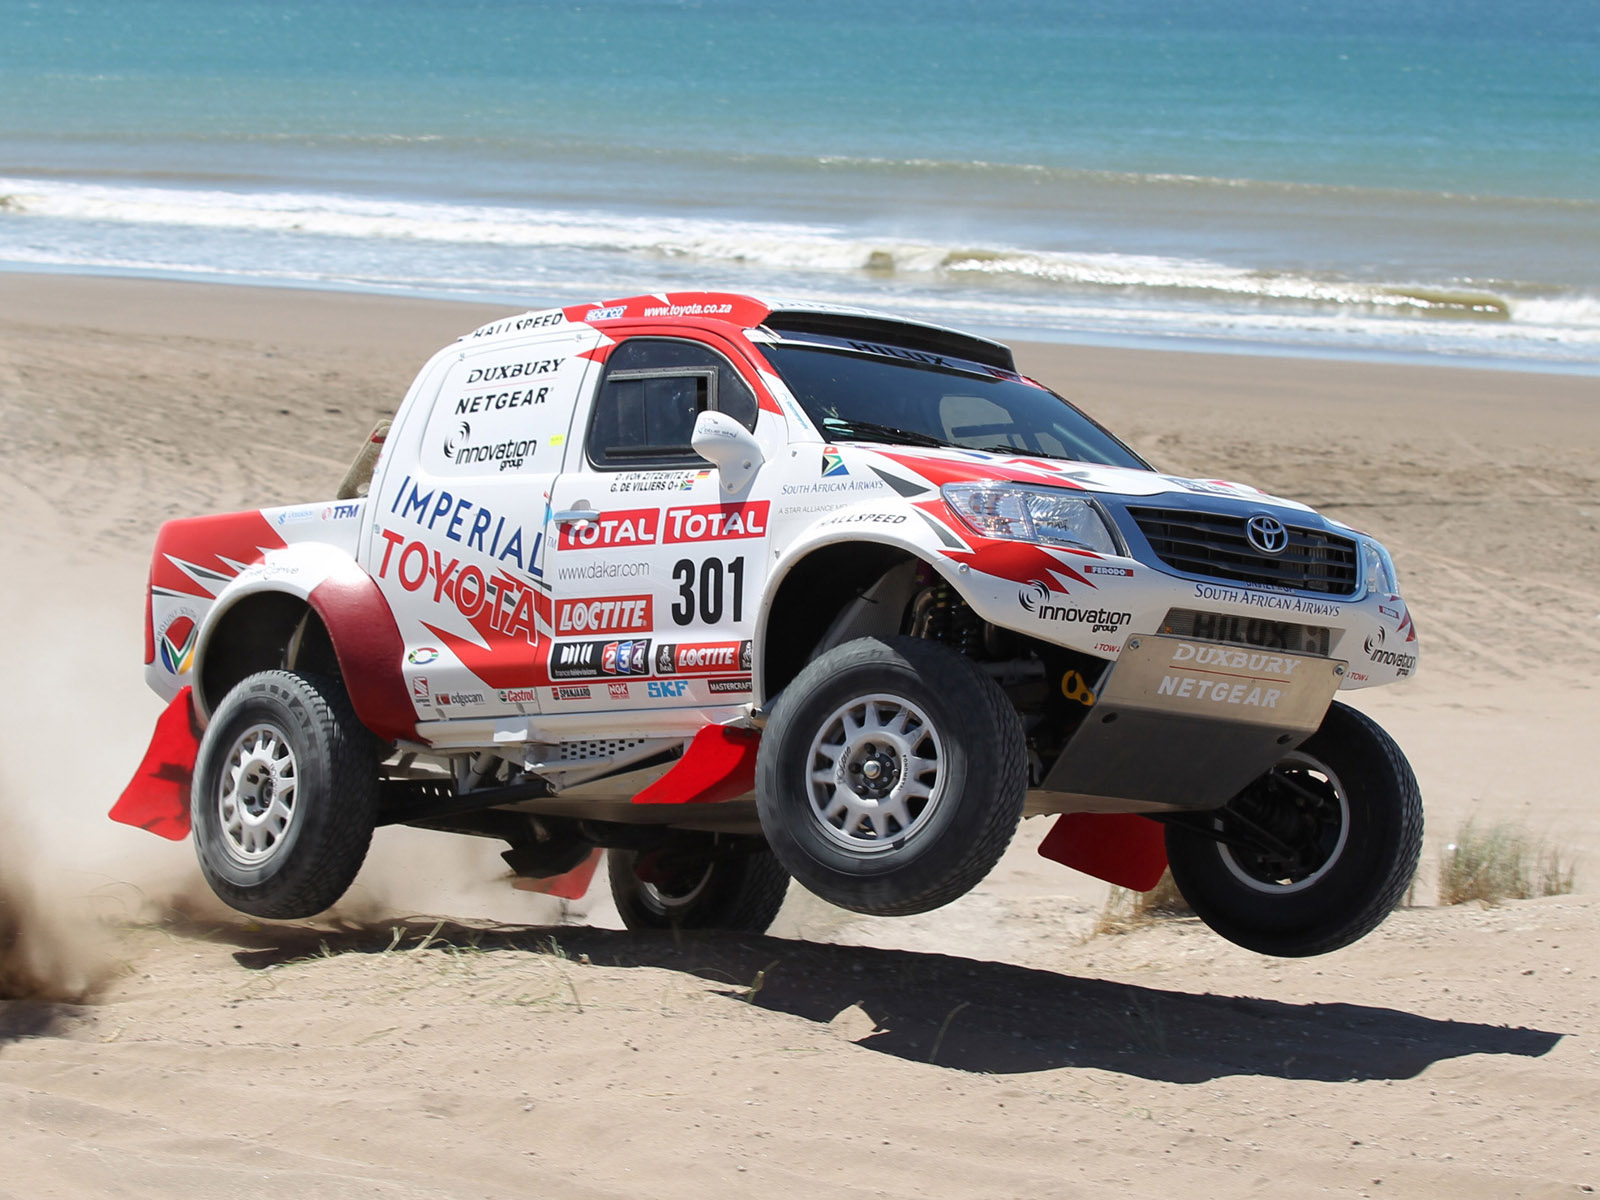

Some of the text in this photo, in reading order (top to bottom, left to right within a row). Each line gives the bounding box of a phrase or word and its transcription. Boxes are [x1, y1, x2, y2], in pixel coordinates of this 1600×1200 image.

[644, 303, 733, 318] www.toyota.co.za
[466, 358, 565, 384] DUXBURY
[455, 387, 548, 415] NETGEAR
[455, 438, 538, 465] innovation
[499, 457, 524, 472] group
[620, 482, 631, 492] DE
[633, 481, 666, 491] VILLIERS
[781, 479, 884, 496] SOUTH AFRICAN AIRWAYS
[333, 504, 360, 519] TFM
[784, 507, 802, 515] STAR
[802, 504, 834, 513] ALLIANCE
[391, 475, 543, 578] IMPERIAL
[669, 509, 765, 539] TOTAL
[558, 561, 650, 581] www.dakar.com
[1091, 566, 1127, 576] FERODO
[378, 528, 538, 648] TOYOTA
[671, 556, 745, 626] 301
[1194, 583, 1237, 603] SOUTH
[1240, 590, 1292, 611] AFRICAN
[1293, 599, 1341, 617] AIRWAYS
[559, 599, 649, 631] LOCTITE
[1038, 605, 1132, 625] innovation
[1092, 624, 1118, 634] group
[678, 647, 735, 666] LOCTITE
[1099, 643, 1117, 653] TOW
[605, 648, 643, 669] 2 3 4
[1172, 643, 1302, 676] DUXBURY
[1370, 648, 1416, 669] innovation
[507, 689, 535, 702] Castrol
[609, 684, 626, 695] NGK
[648, 681, 689, 698] SKF
[709, 682, 752, 691] MASTERCRAFT
[1157, 675, 1283, 708] NETGEAR
[451, 691, 483, 706] edgecam
